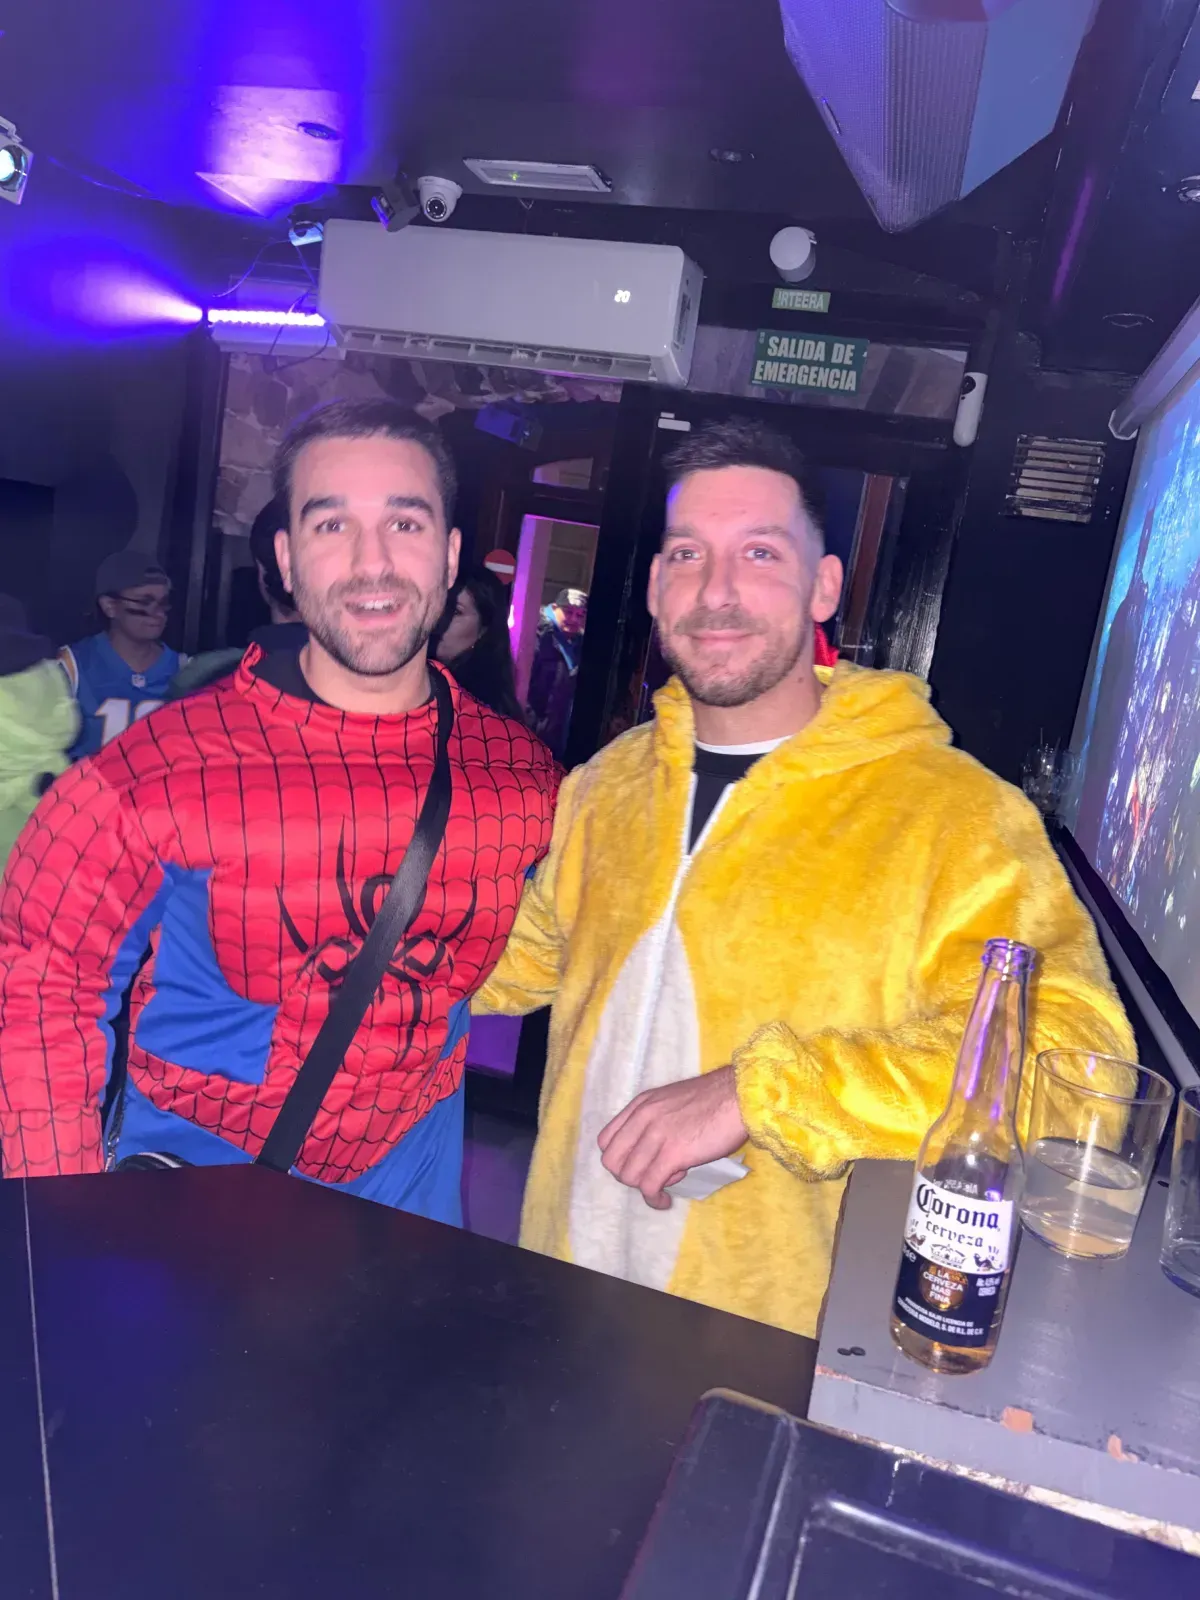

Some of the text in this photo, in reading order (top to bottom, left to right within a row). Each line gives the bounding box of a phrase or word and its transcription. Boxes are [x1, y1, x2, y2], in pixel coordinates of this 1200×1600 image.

[614, 289, 631, 303] 20
[777, 291, 824, 310] IRTEERA
[767, 336, 826, 361] SALIDA
[831, 342, 855, 365] DE
[754, 360, 857, 391] EMERGENCIA
[917, 1183, 999, 1229] Corona
[925, 1220, 984, 1247] cerveza
[923, 1271, 964, 1292] CERVEZA
[937, 1269, 950, 1280] LA
[929, 1290, 951, 1305] FINA
